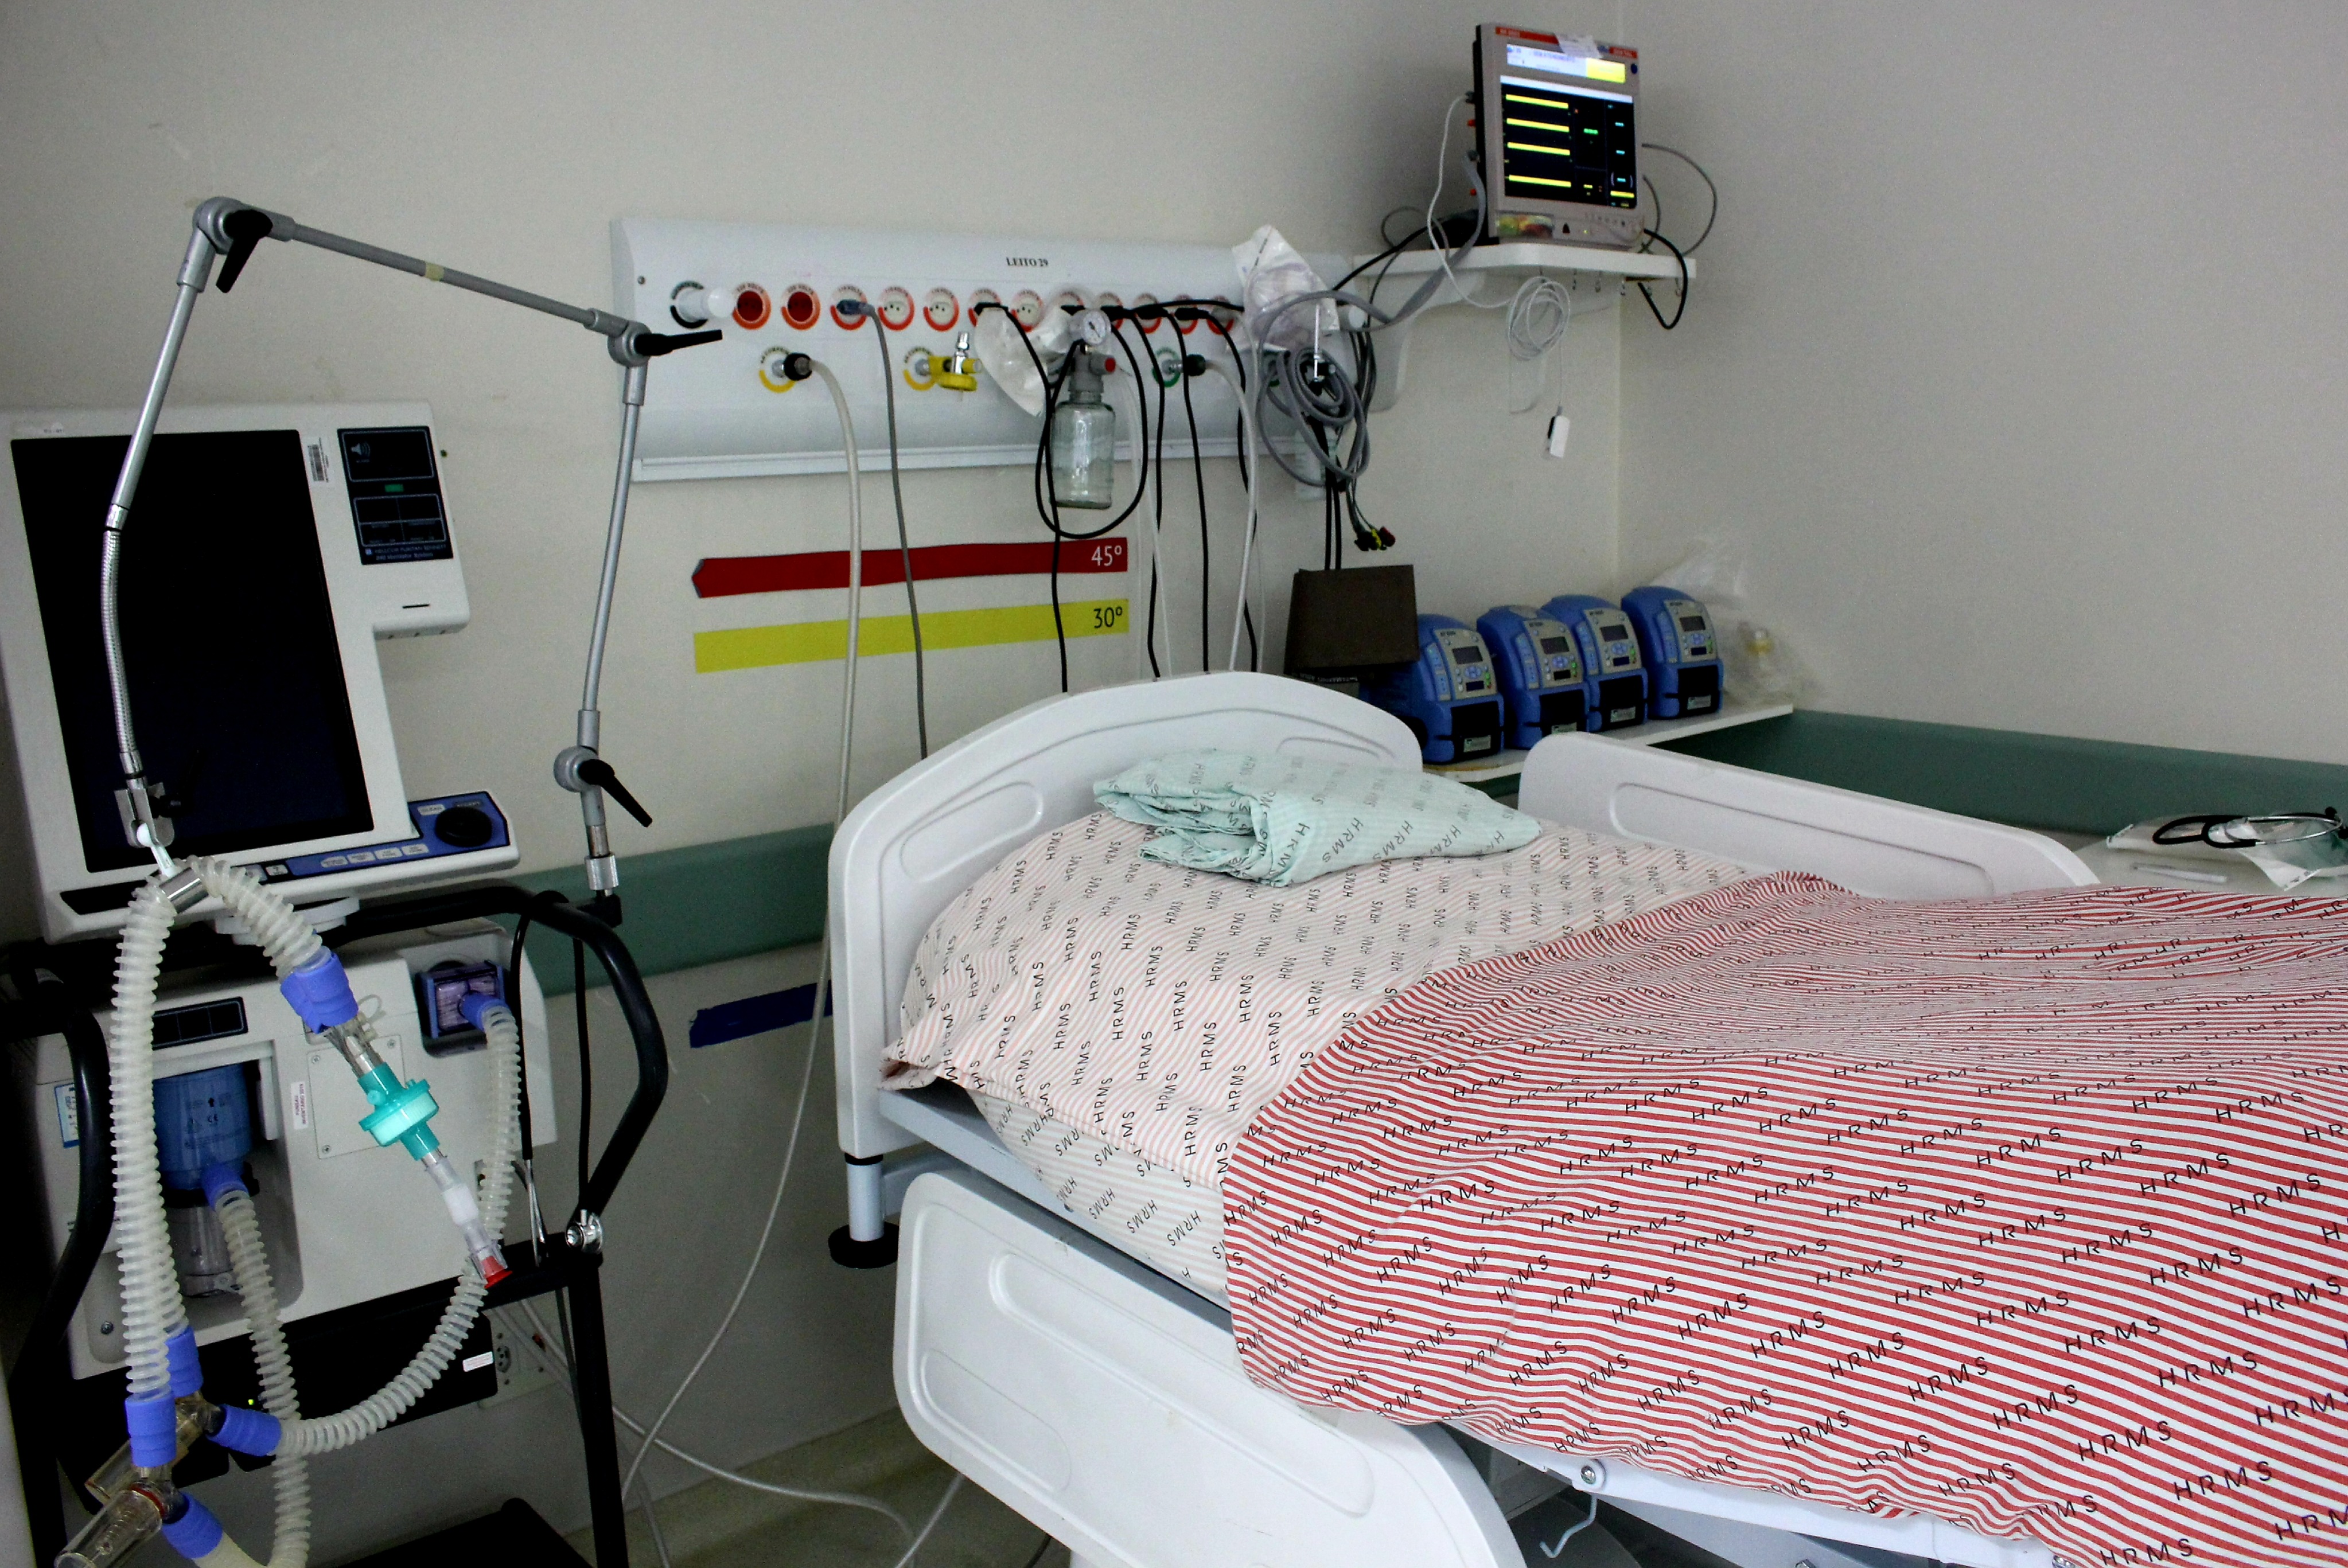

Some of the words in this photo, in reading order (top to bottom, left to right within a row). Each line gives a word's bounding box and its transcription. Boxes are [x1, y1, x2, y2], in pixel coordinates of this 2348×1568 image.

[1006, 257, 1037, 267] LEITO
[1039, 258, 1049, 267] 29
[1146, 946, 1162, 987] HRMS
[1240, 974, 1253, 1023] HRMS
[1053, 1003, 1070, 1050] HRMS
[1269, 1012, 1282, 1066] HRMS
[1376, 1016, 1441, 1027] HRMS
[1072, 1041, 1090, 1085] HRMS
[1136, 1031, 1152, 1081] HRMS
[1201, 1022, 1216, 1071] HRMS
[1353, 1054, 1418, 1073] HRMS
[1400, 1062, 1466, 1081] HRMS
[1454, 1072, 1522, 1098] HRMS
[1833, 1059, 1913, 1078] HRMS
[1905, 1066, 1987, 1087] HRMS
[1978, 1072, 2060, 1097] HRMS
[1095, 1077, 1112, 1124] HRMS
[1157, 1072, 1177, 1112] HRMS
[1229, 1064, 1245, 1113] HRMS
[1284, 1089, 1347, 1108] HRMS
[1509, 1078, 1580, 1107] HRMS
[1567, 1078, 1638, 1109] HRMS
[1626, 1079, 1699, 1113] HRMS
[1693, 1087, 1768, 1122] HRMS
[2053, 1074, 2136, 1103] HRMS
[2133, 1076, 2219, 1112] HRMS
[2216, 1092, 2305, 1121] HRMS
[1332, 1098, 1397, 1125] HRMS
[1384, 1117, 1452, 1138] HRMS
[1760, 1098, 1836, 1133] HRMS
[1827, 1109, 1909, 1144] HRMS
[1185, 1106, 1204, 1156] HRMS
[1439, 1125, 1509, 1156] HRMS
[1494, 1130, 1570, 1158] HRMS
[1901, 1118, 1983, 1156] HRMS
[1977, 1128, 2061, 1168] HRMS
[1263, 1142, 1328, 1168] HRMS
[1315, 1159, 1380, 1185] HRMS
[1560, 1136, 1633, 1175] HRMS
[1621, 1144, 1697, 1178] HRMS
[1686, 1155, 1763, 1189] HRMS
[2056, 1139, 2143, 1183] HRMS
[1369, 1173, 1436, 1204] HRMS
[1755, 1167, 1833, 1203] HRMS
[2141, 1152, 2230, 1196] HRMS
[1420, 1181, 1497, 1211] HRMS
[1481, 1192, 1558, 1224] HRMS
[1827, 1180, 1909, 1216] HRMS
[1901, 1193, 1986, 1230] HRMS
[2230, 1173, 2322, 1216] HRMS
[1270, 1211, 1323, 1247] HRMS
[1541, 1200, 1621, 1232] HRMS
[1606, 1211, 1688, 1243] HRMS
[1979, 1208, 2066, 1246] HRMS
[1323, 1230, 1377, 1268] HRMS
[1673, 1225, 1754, 1254] HRMS
[1742, 1239, 1827, 1269] HRMS
[2063, 1223, 2153, 1262] HRMS
[1377, 1238, 1434, 1284] HRMS
[1439, 1247, 1489, 1295] HRMS
[1816, 1255, 1903, 1285] HRMS
[2150, 1247, 2244, 1286] HRMS
[1248, 1274, 1290, 1305] HRMS
[1497, 1255, 1549, 1304] HRMS
[1549, 1264, 1613, 1313] HRMS
[1894, 1272, 1985, 1303] HRMS
[2243, 1274, 2342, 1318] HRMS
[1292, 1295, 1338, 1329] HRMS
[1611, 1277, 1677, 1324] HRMS
[1678, 1293, 1749, 1340] HRMS
[1977, 1292, 2070, 1326] HRMS
[1341, 1309, 1396, 1351] HRMS
[1403, 1323, 1458, 1362] HRMS
[1751, 1311, 1825, 1358] HRMS
[2065, 1317, 2162, 1353] HRMS
[1508, 1341, 1568, 1387] HRMS
[1829, 1332, 1905, 1379] HRMS
[2159, 1351, 2258, 1387] HRMS
[1321, 1370, 1370, 1403] HRMS
[1578, 1354, 1630, 1394] HRMS
[1638, 1370, 1701, 1410] HRMS
[1908, 1356, 1989, 1402] HRMS
[1710, 1389, 1773, 1429] HRMS
[1993, 1384, 2079, 1430] HRMS
[1555, 1422, 1600, 1453] HRMS
[1782, 1410, 1850, 1451] HRMS
[2078, 1421, 2172, 1461] HRMS
[1858, 1435, 1931, 1472] HRMS
[1938, 1462, 2016, 1497] HRMS
[2174, 1461, 2272, 1500] HRMS
[2101, 1539, 2193, 1566] HRMS
